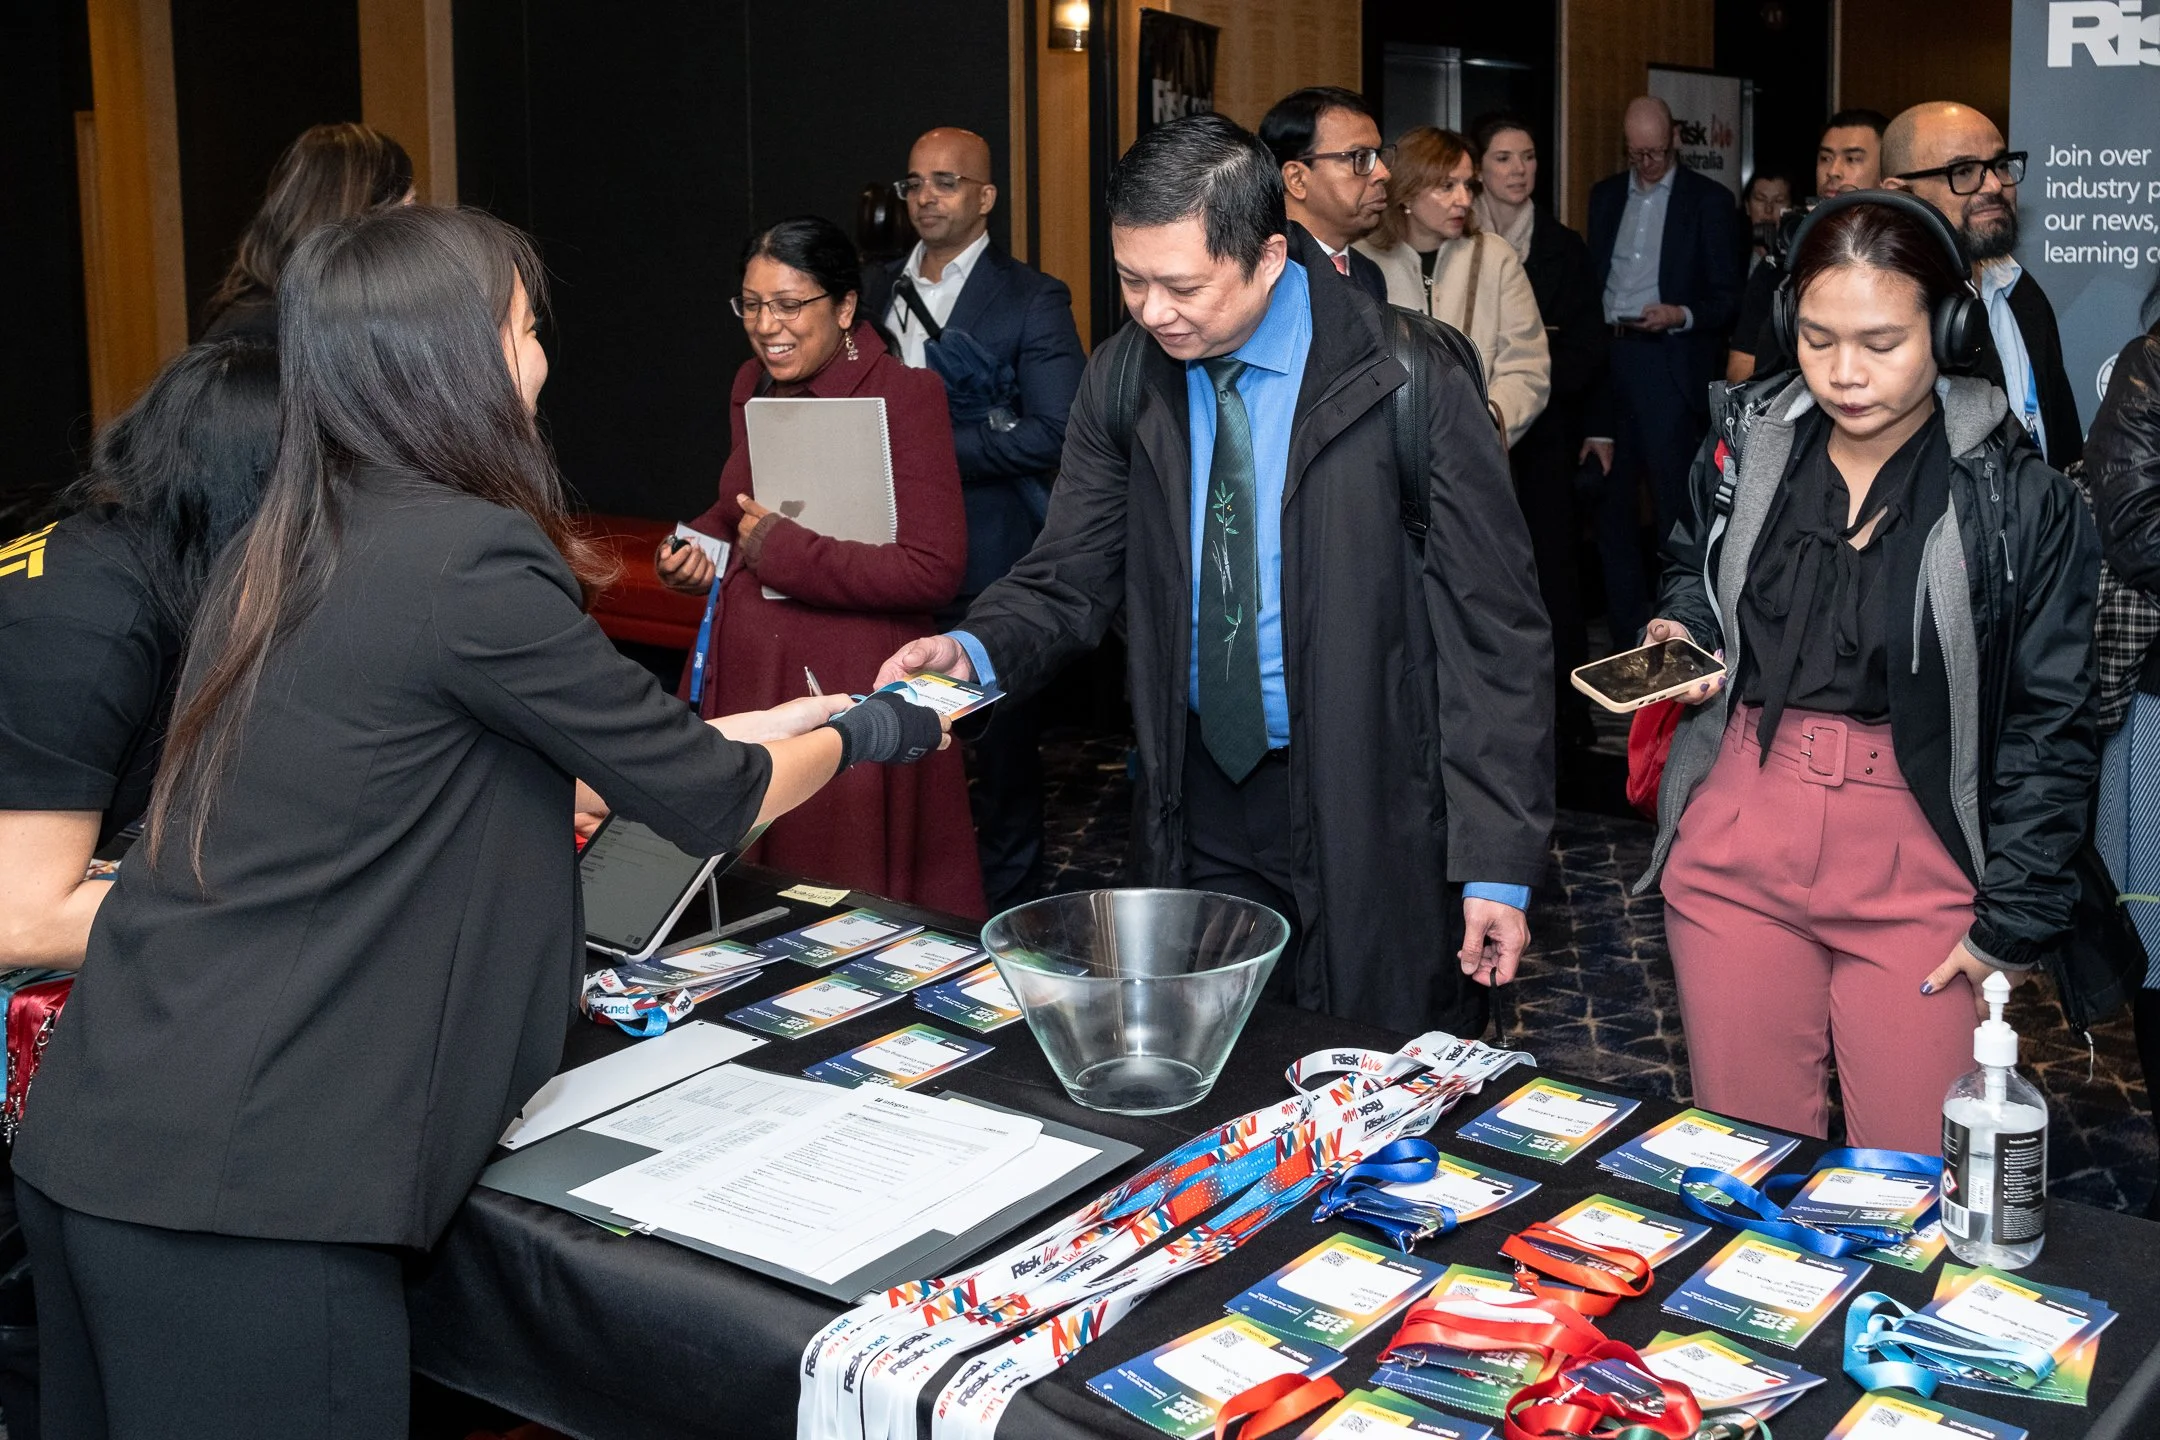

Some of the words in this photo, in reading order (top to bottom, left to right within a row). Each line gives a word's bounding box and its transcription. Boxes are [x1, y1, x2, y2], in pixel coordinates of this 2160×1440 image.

[2045, 144, 2091, 167] Join
[2100, 149, 2151, 167] over
[2046, 176, 2140, 204] industry
[2045, 213, 2085, 231] our
[2093, 212, 2159, 234] news,
[2044, 240, 2139, 269] learning
[1331, 1053, 1359, 1067] Risk
[1360, 1053, 1384, 1072] Live
[1357, 1099, 1384, 1117] Risk
[1011, 1255, 1041, 1279] Risk
[1055, 1254, 1109, 1283] Risk.net
[1786, 1299, 1810, 1307] Otto
[805, 1318, 852, 1378] Risk.net
[888, 1336, 955, 1375] Risk.net
[843, 1334, 891, 1394] Risk.net
[957, 1357, 1018, 1407] Risk.net
